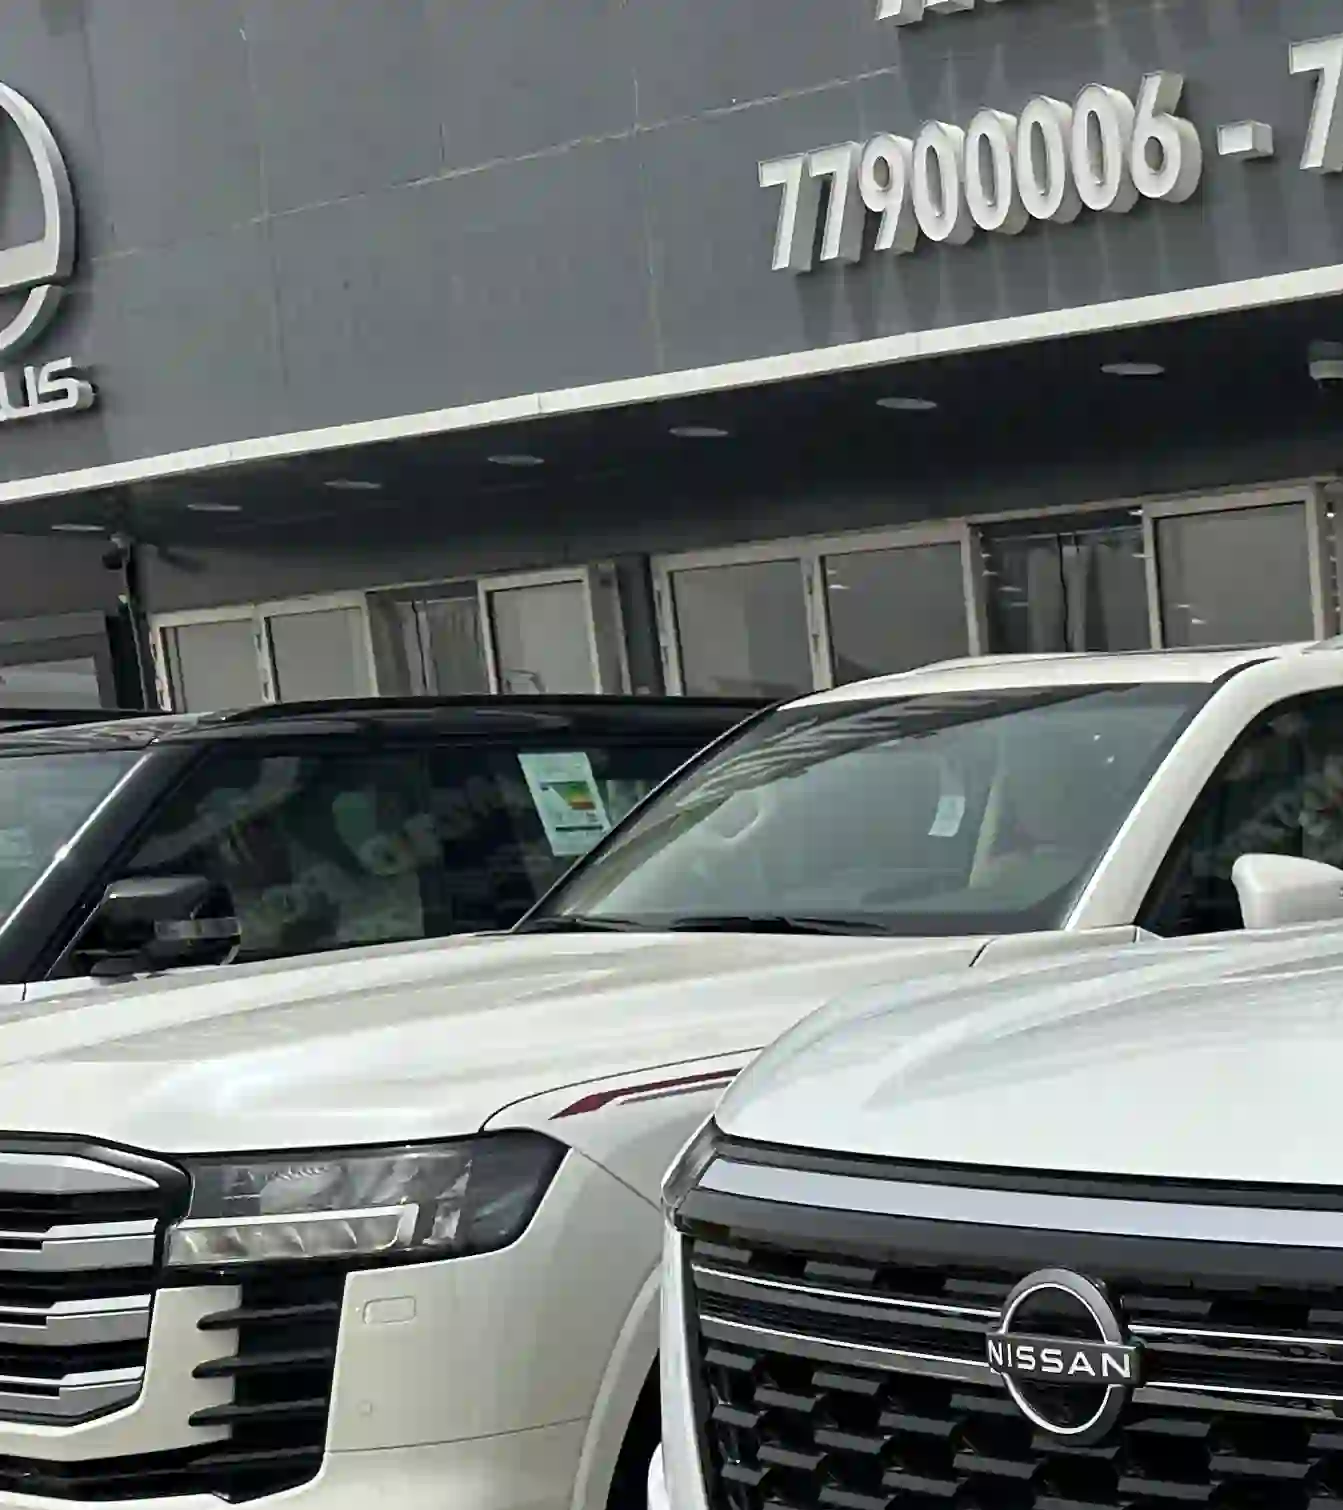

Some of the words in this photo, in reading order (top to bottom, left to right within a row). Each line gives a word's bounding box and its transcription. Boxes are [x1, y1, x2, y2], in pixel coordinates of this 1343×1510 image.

[758, 70, 1202, 272] 77900006
[0, 357, 95, 421] US
[987, 1339, 1132, 1378] NISSAN
